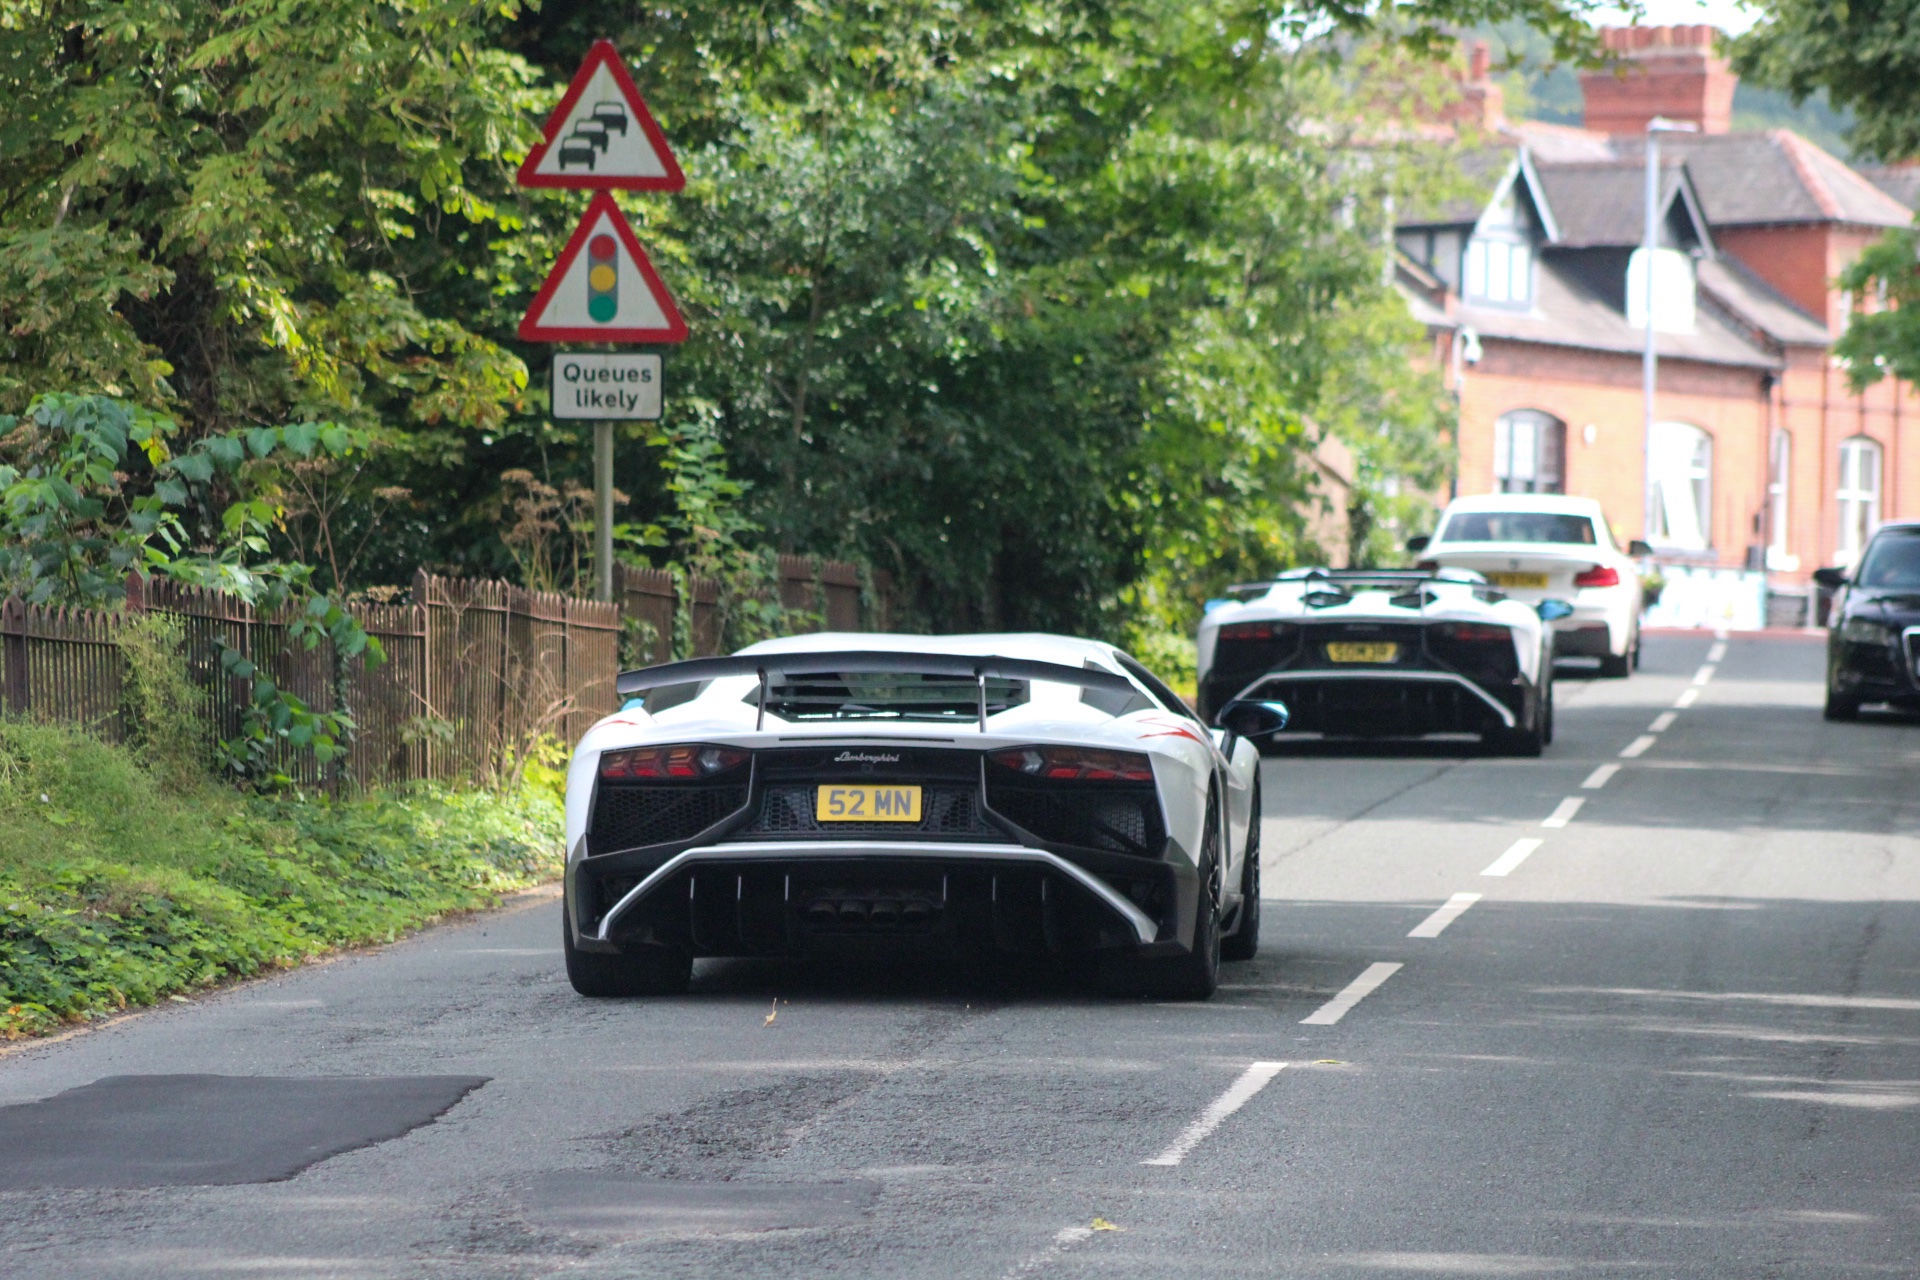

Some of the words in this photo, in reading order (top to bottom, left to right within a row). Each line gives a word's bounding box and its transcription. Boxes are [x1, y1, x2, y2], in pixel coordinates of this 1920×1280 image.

[563, 363, 652, 383] Queues
[576, 389, 638, 411] likely
[834, 751, 900, 763] Lamborghini
[828, 789, 866, 816] 52
[874, 790, 912, 816] MN
